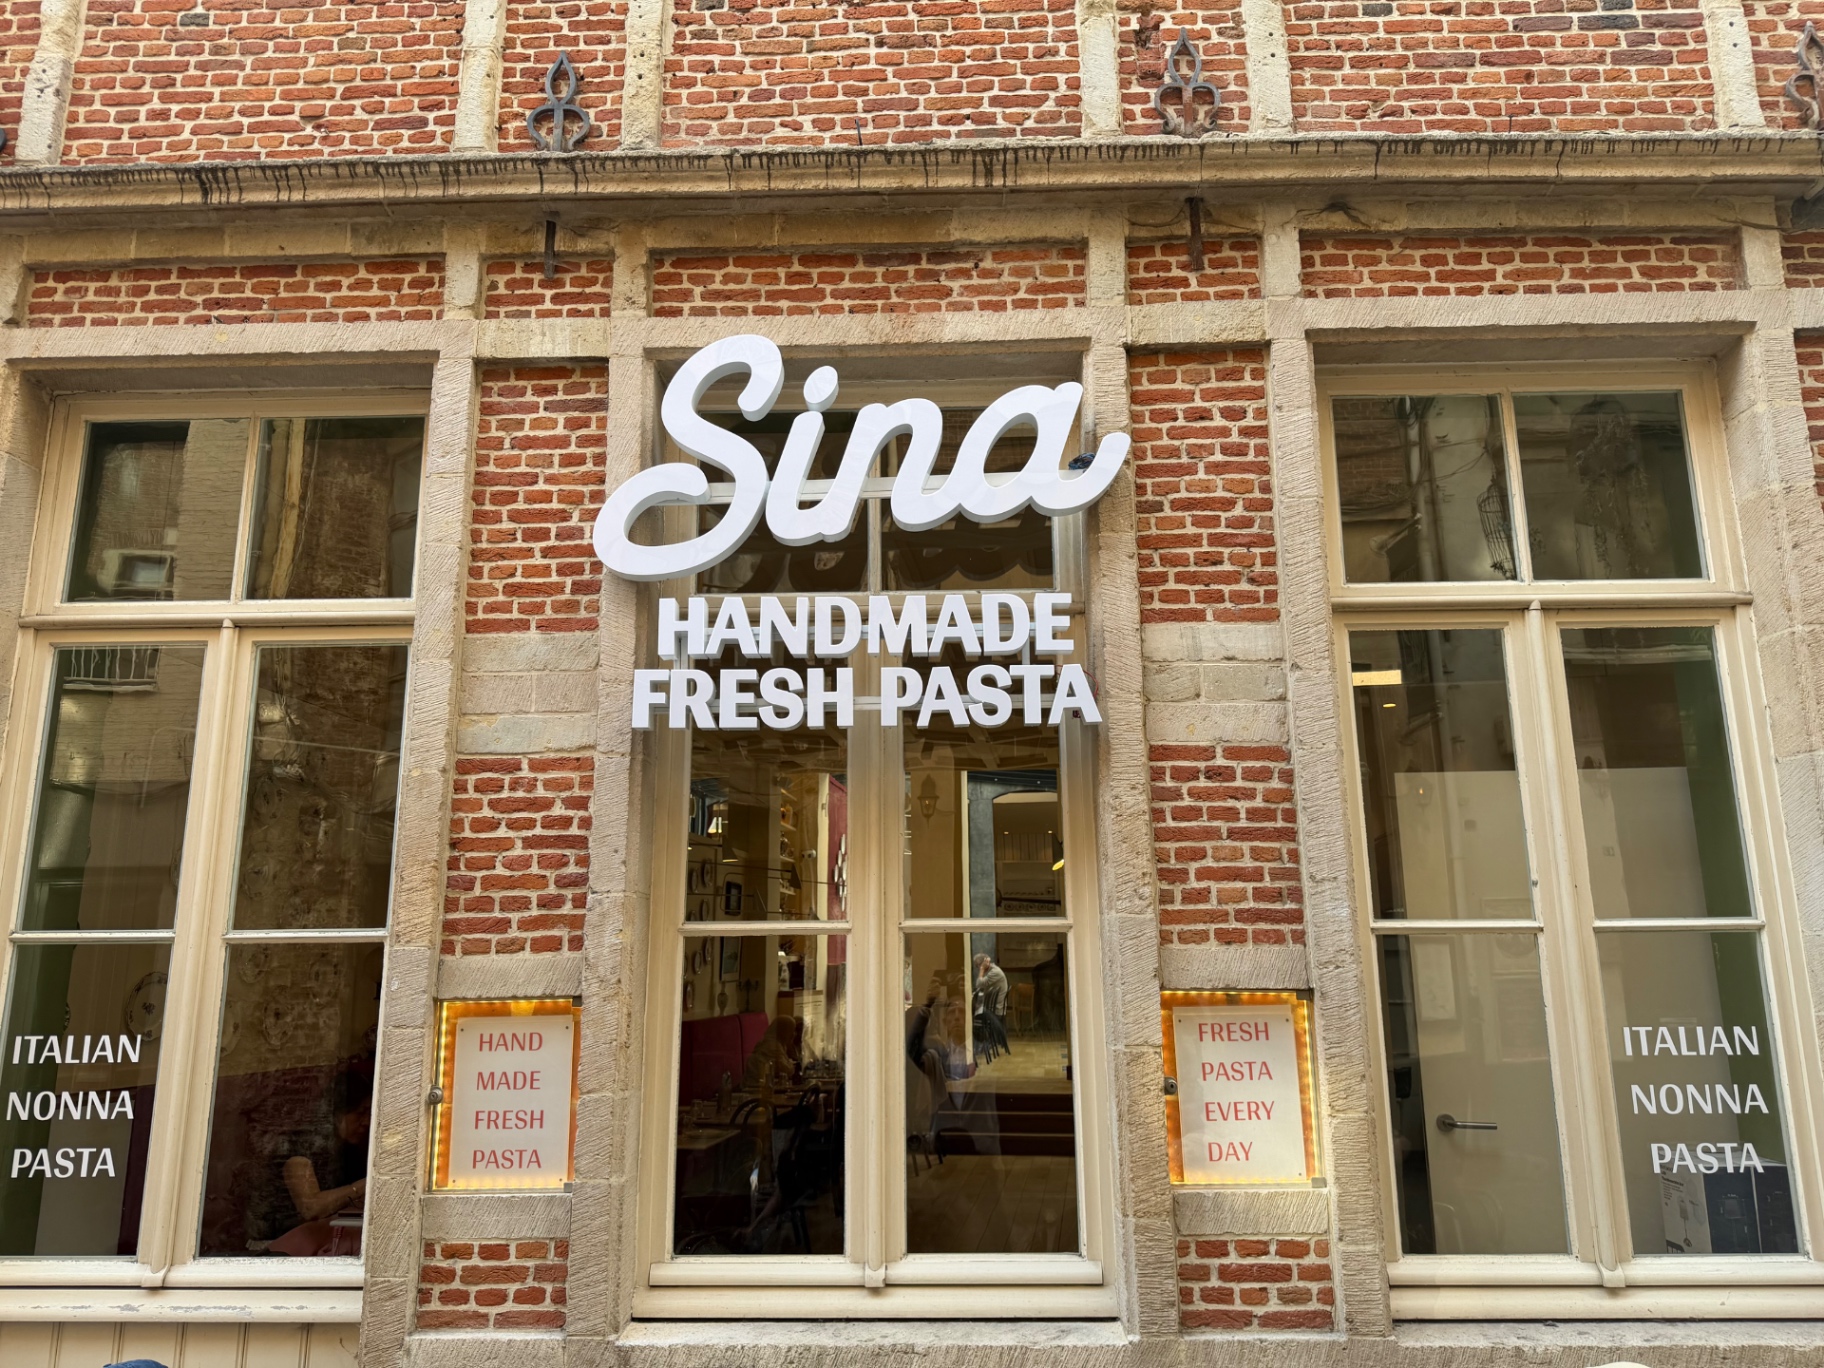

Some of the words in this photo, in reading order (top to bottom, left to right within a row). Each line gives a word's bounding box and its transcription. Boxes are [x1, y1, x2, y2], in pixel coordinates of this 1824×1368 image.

[593, 334, 1131, 581] Sina
[658, 592, 1075, 660] HANDMADE
[631, 666, 854, 730] FRESH
[880, 663, 1103, 728] PASTA
[479, 1032, 543, 1052] HAND
[1198, 1021, 1270, 1042] FRESH
[1622, 1026, 1760, 1056] ITALIAN
[12, 1034, 142, 1064] ITALIAN
[476, 1070, 541, 1091] MADE
[1201, 1061, 1273, 1081] PASTA
[6, 1090, 134, 1121] NONNA
[1204, 1100, 1275, 1121] EVERY
[1630, 1083, 1769, 1115] NONNA
[474, 1109, 545, 1130] FRESH
[10, 1147, 116, 1179] PASTA
[472, 1149, 542, 1170] PASTA
[1207, 1141, 1253, 1162] DAY
[1650, 1142, 1765, 1174] PASTA
